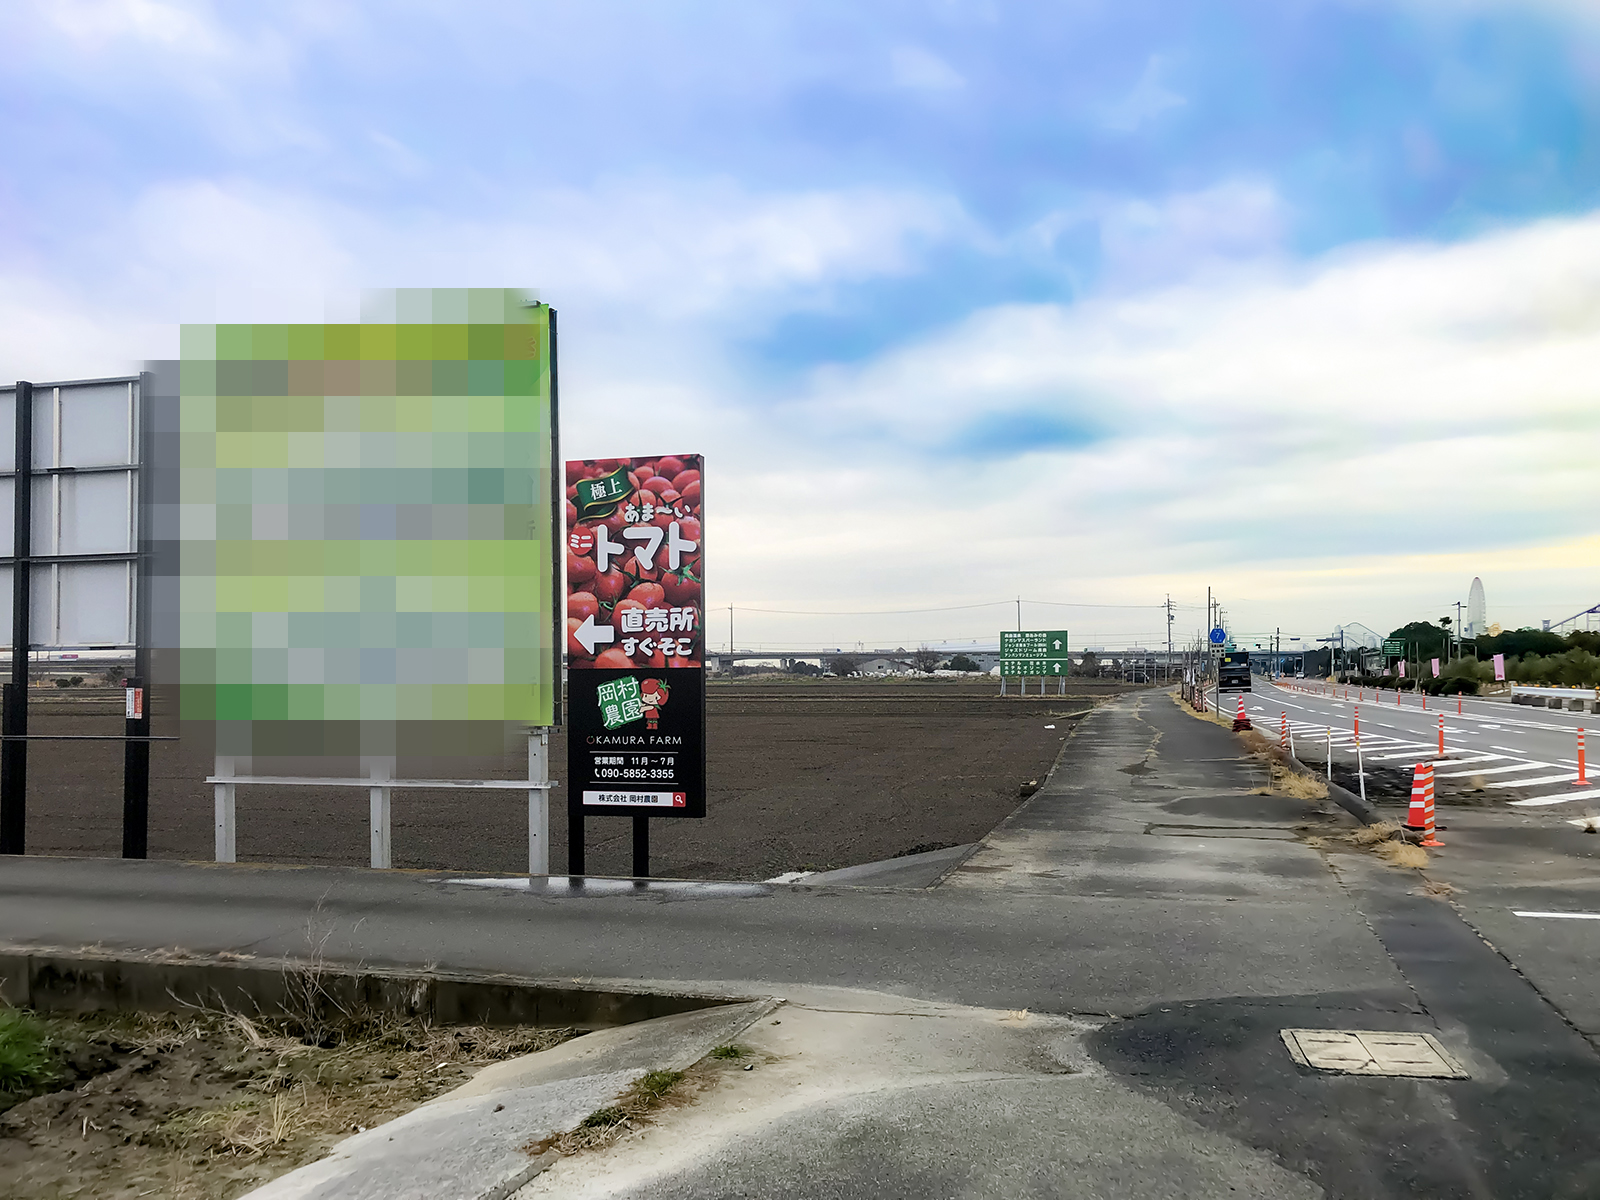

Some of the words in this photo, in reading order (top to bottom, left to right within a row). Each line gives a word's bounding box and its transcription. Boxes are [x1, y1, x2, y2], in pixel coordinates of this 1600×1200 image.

[590, 478, 623, 500] 極上
[570, 533, 593, 549] ミニ
[597, 521, 697, 573] トマト
[620, 607, 694, 633] 直売所
[621, 637, 693, 657] すぐそこ
[597, 677, 639, 706] 岡村
[603, 698, 643, 727] 農園
[586, 735, 645, 745] OKAMURA
[649, 736, 682, 745] FARM
[594, 756, 624, 765] 営業期間
[601, 768, 674, 778] 090-5852-3355
[598, 794, 627, 803] 株式会社
[629, 795, 658, 803] 岡村農園
